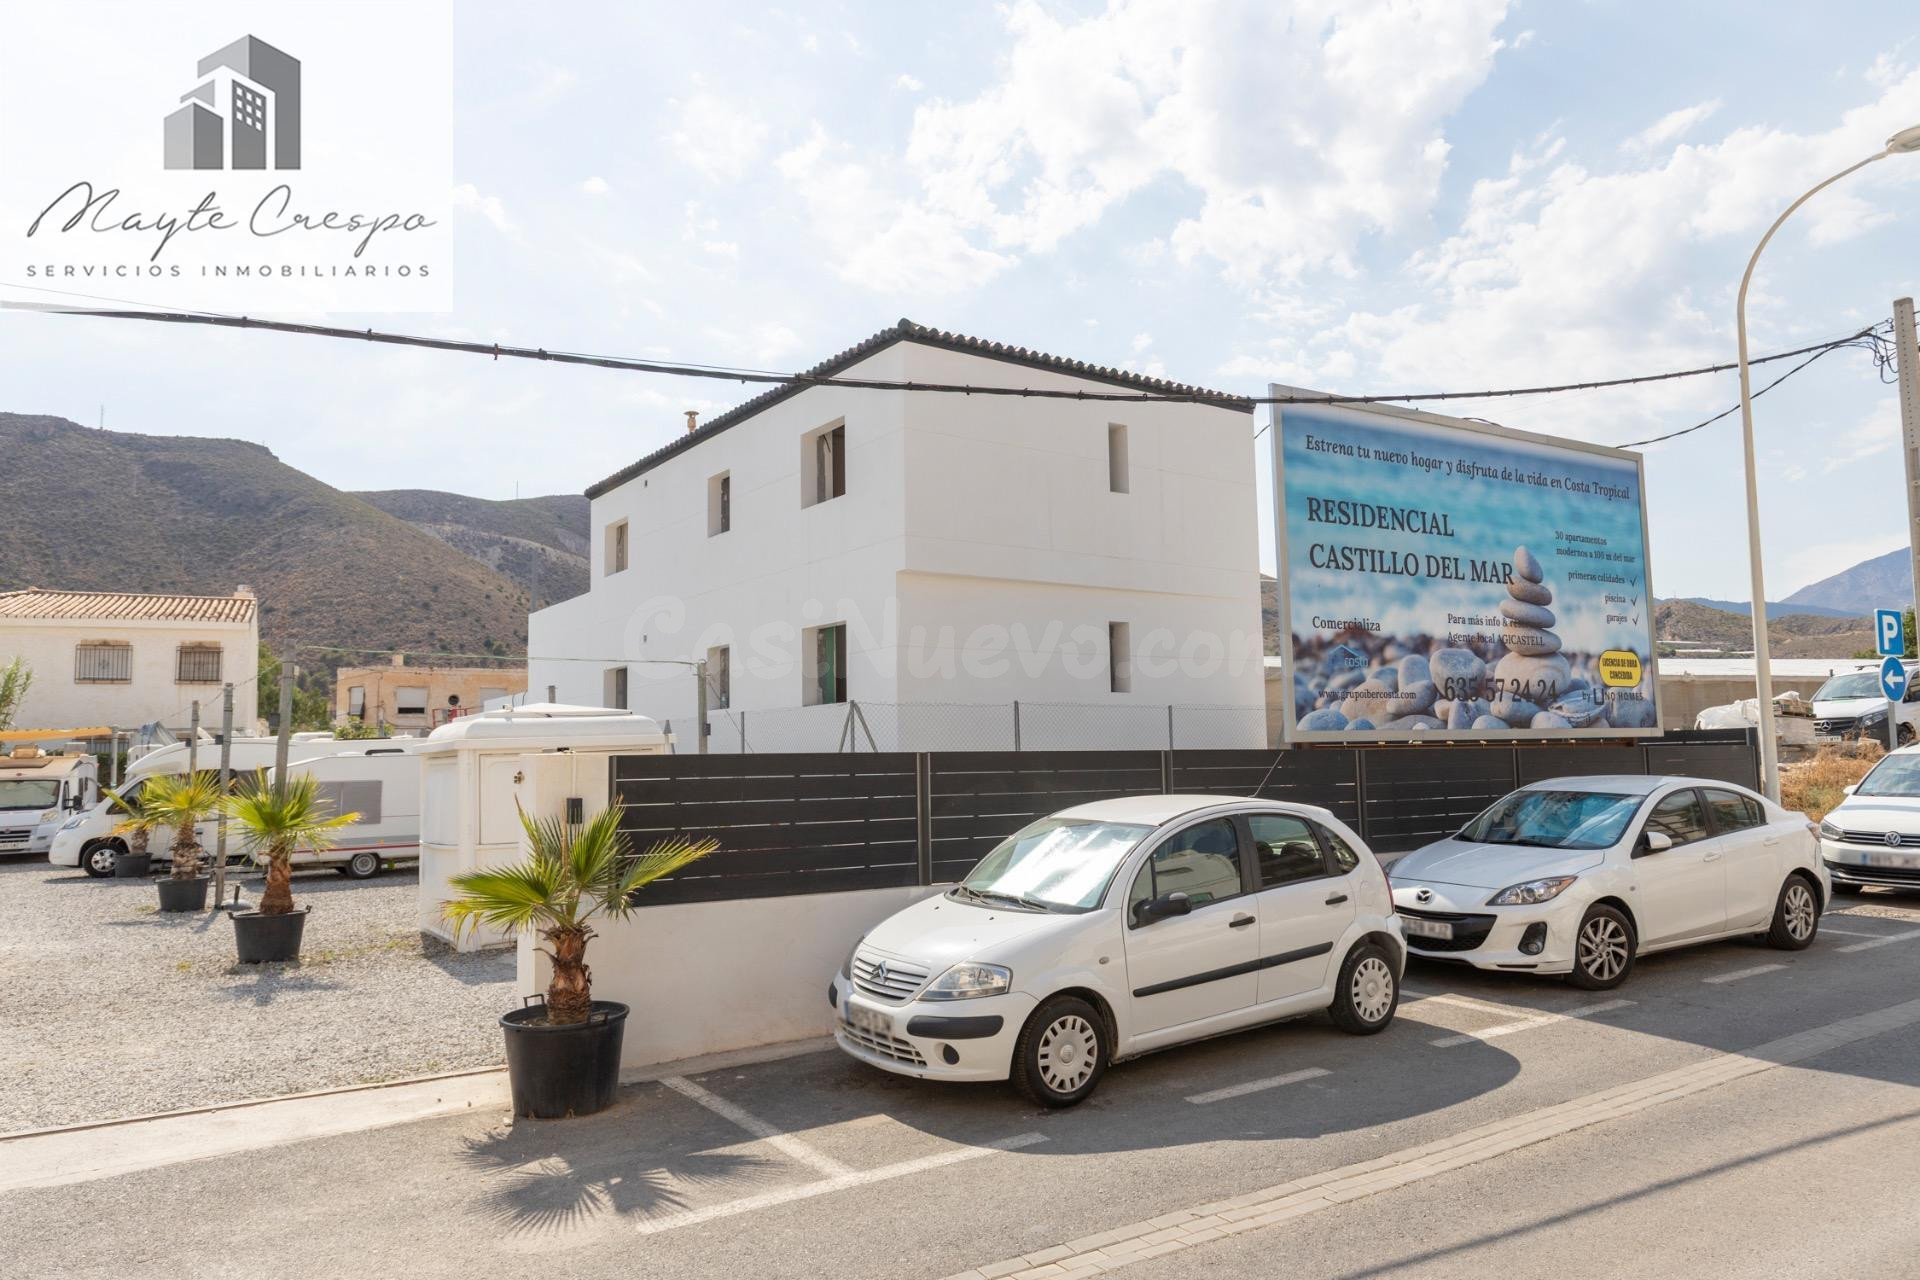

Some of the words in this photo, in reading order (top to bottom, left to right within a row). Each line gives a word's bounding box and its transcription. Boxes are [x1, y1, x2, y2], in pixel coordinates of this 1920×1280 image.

[1306, 434, 1354, 457] Estrena
[1357, 445, 1371, 458] tu
[1374, 449, 1408, 465] nuevo
[1411, 451, 1443, 472] hogar
[1446, 460, 1453, 475] y
[1456, 459, 1498, 480] disfruta
[1501, 466, 1512, 480] de
[1515, 468, 1524, 483] la
[1527, 471, 1549, 487] vida
[1551, 479, 1562, 489] en
[1564, 477, 1590, 493] Costa
[1592, 481, 1630, 500] Tropical
[1306, 497, 1455, 537] RESIDENCIAL
[1565, 533, 1607, 546] apartamentos
[1556, 547, 1588, 558] modernos
[1309, 543, 1420, 577] CASTILLO
[1425, 554, 1465, 581] DEL
[1470, 559, 1515, 585] MAR
[1568, 570, 1596, 582] primeras
[1598, 571, 1625, 584] calidades
[1605, 593, 1626, 605] piscina
[1312, 616, 1381, 632] Comercializa
[1447, 613, 1466, 624] Para
[1467, 614, 1484, 626] más
[1485, 615, 1500, 627] info
[1606, 614, 1627, 624] garajes
[1447, 631, 1475, 646] Agente
[1476, 632, 1495, 644] local
[1882, 614, 1898, 650] P
[1318, 689, 1417, 701] www.grupoibercosta.com
[1445, 677, 1479, 702] 635
[1485, 678, 1506, 702] 57
[1511, 678, 1532, 703] 24
[1537, 679, 1557, 702] 24
[1617, 692, 1644, 701] HOMES
